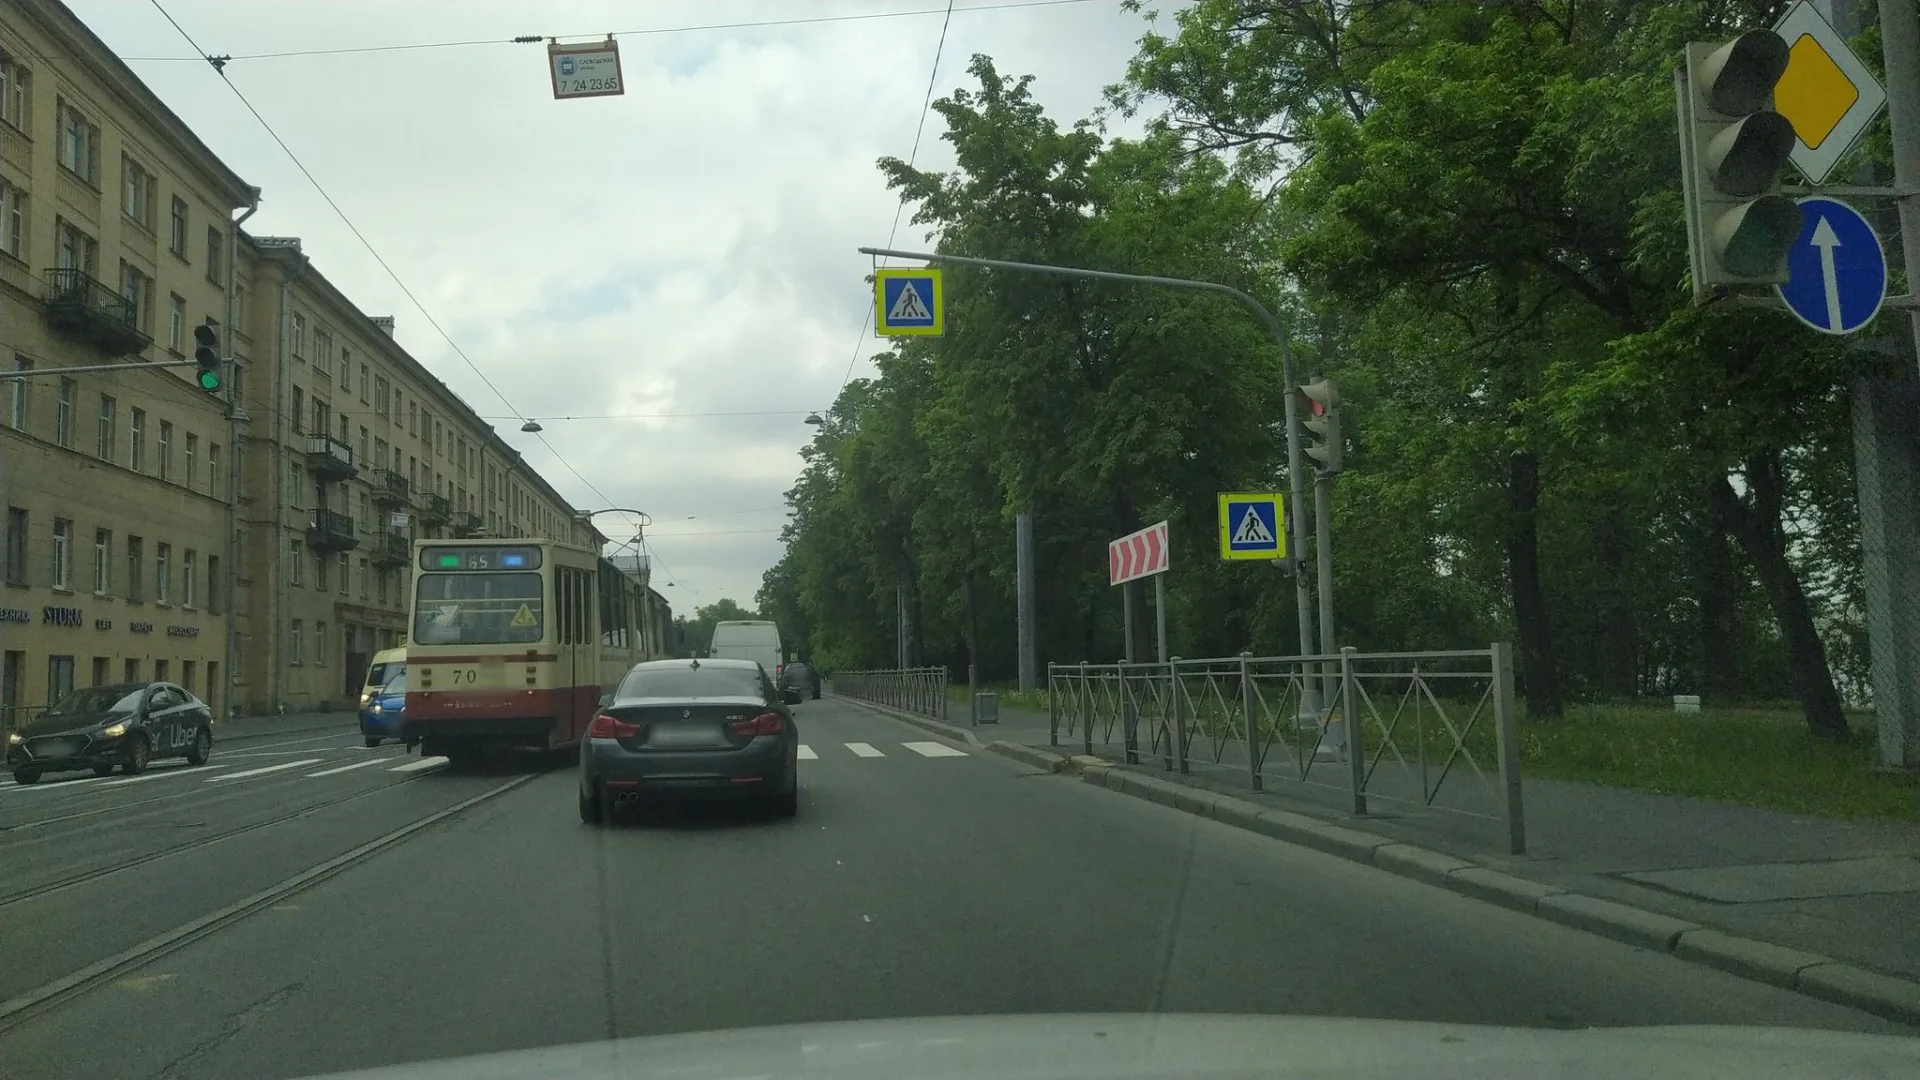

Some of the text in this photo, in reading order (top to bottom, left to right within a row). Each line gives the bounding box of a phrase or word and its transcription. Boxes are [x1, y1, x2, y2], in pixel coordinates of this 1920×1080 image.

[561, 78, 617, 92] 7 24 23 65
[453, 669, 477, 684] 70
[171, 723, 198, 748] Uber
